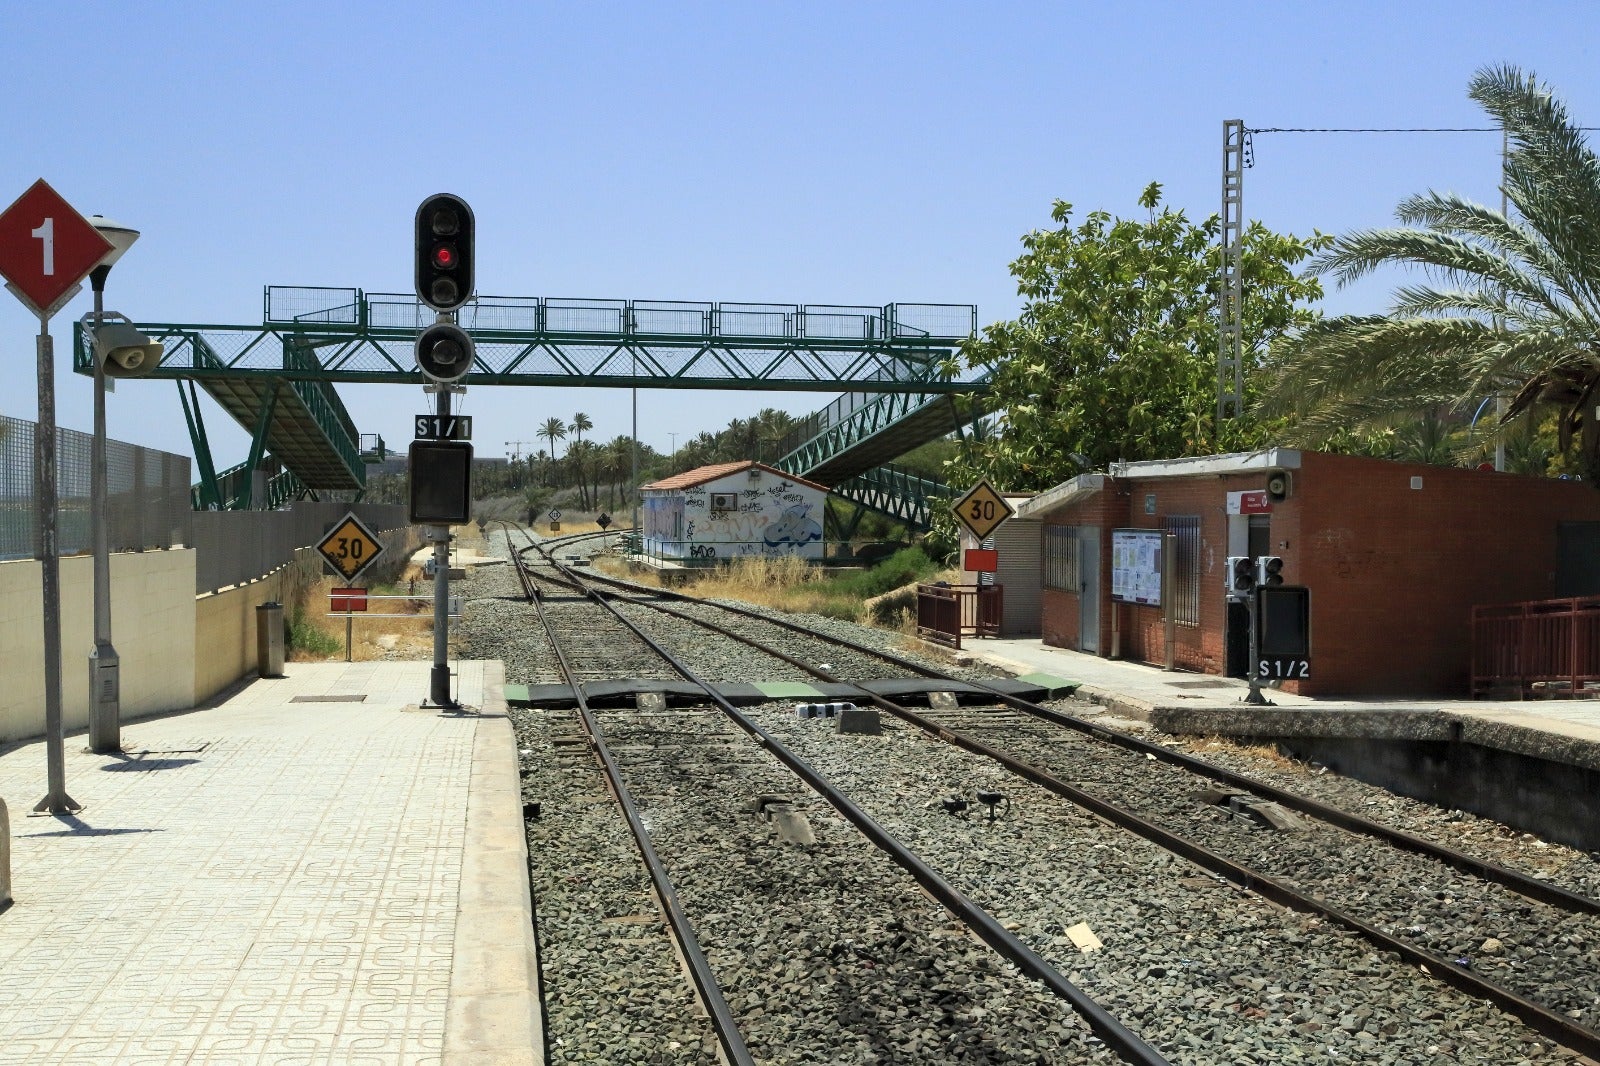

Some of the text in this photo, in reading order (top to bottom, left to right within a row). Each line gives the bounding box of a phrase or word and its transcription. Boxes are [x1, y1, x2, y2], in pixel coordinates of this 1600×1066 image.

[31, 217, 54, 276] 1
[417, 418, 469, 437] S1/1
[970, 499, 995, 521] 30
[337, 537, 363, 560] 30
[1260, 660, 1309, 678] S1/2
